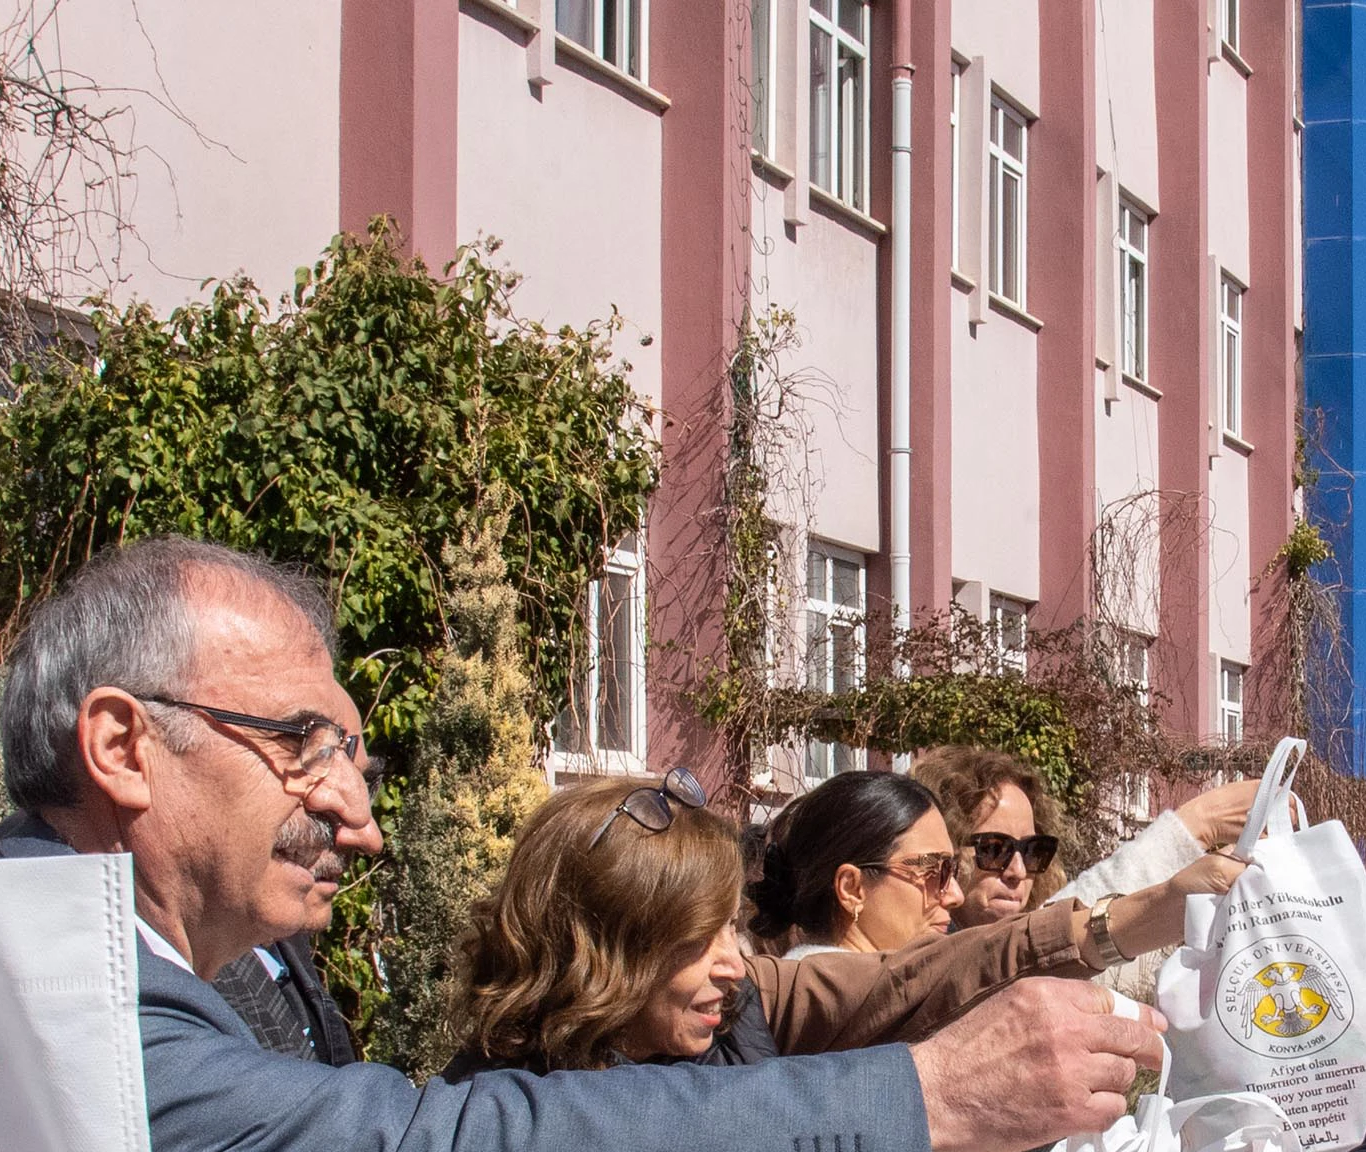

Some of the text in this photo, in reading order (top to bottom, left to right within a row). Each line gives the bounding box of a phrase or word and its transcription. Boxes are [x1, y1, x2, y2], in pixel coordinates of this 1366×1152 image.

[1226, 959, 1252, 1013] SELÇUK
[1268, 1034, 1326, 1053] KONYA-1908
[1270, 1057, 1338, 1078] Afiyet olsun
[1315, 1064, 1366, 1080] аппетита
[1268, 1079, 1356, 1106] njoy your meal!
[1281, 1096, 1349, 1116] uten appetit
[1309, 1111, 1346, 1128] appétit
